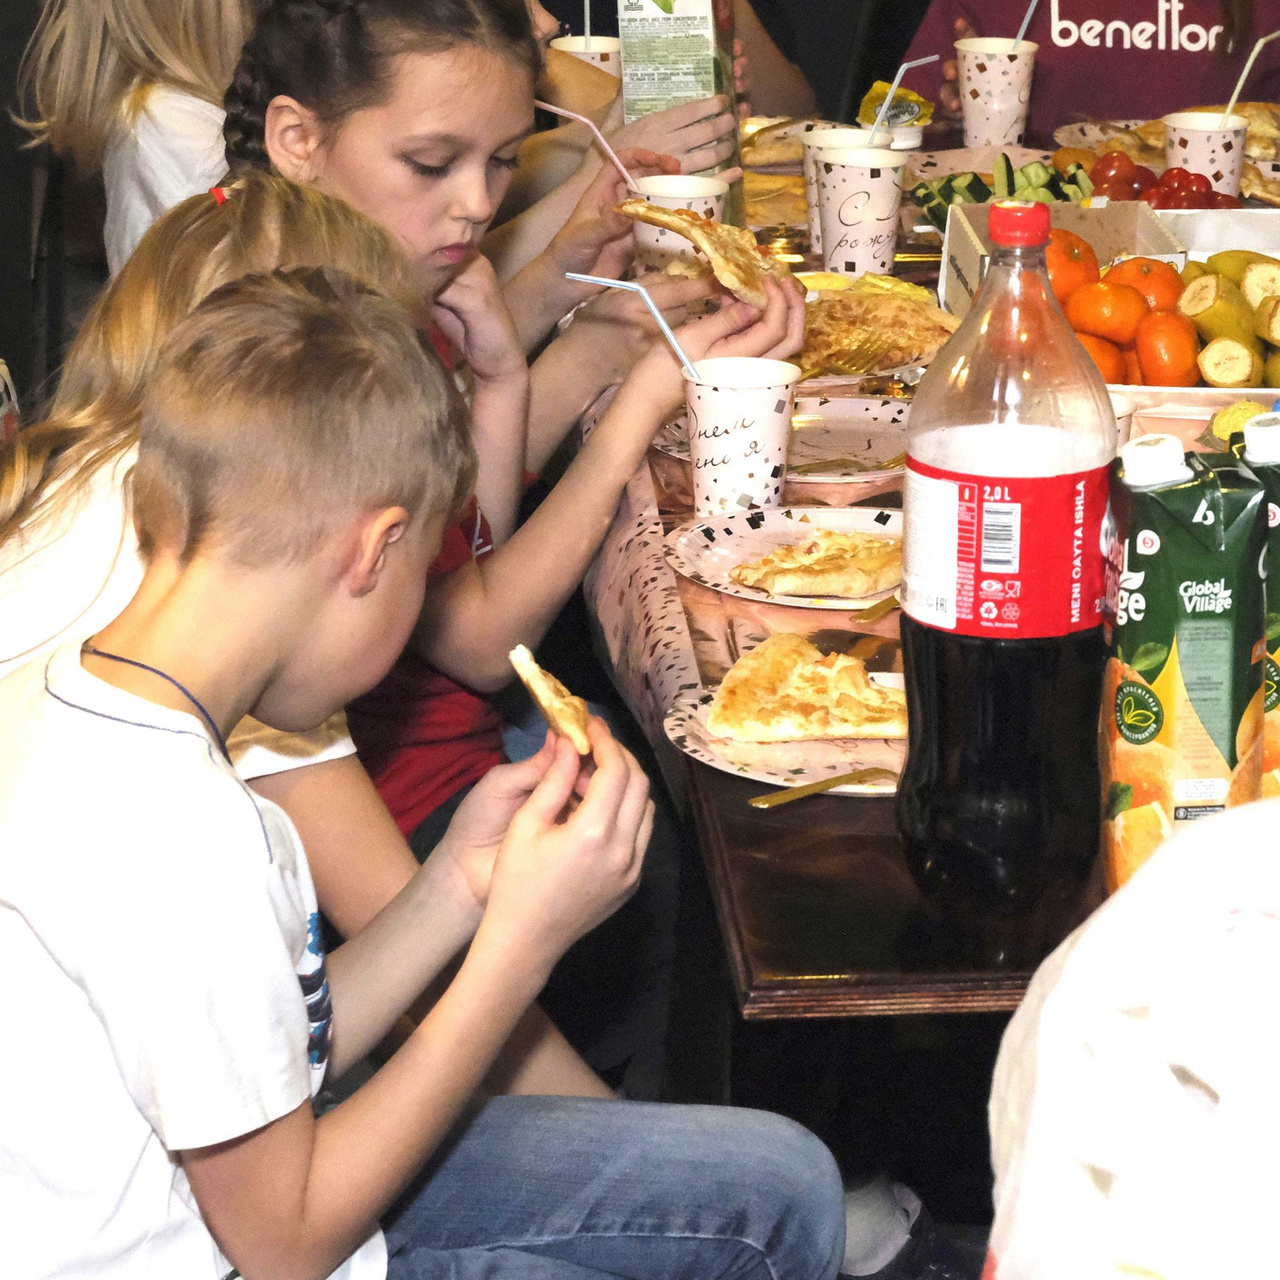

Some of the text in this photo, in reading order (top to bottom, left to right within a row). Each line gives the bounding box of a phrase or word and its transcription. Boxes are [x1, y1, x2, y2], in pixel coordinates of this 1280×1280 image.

[983, 485, 1011, 502] 2,0 L
[1074, 480, 1086, 524] ISHLA
[1179, 578, 1232, 597] Global
[1070, 583, 1081, 623] MENI
